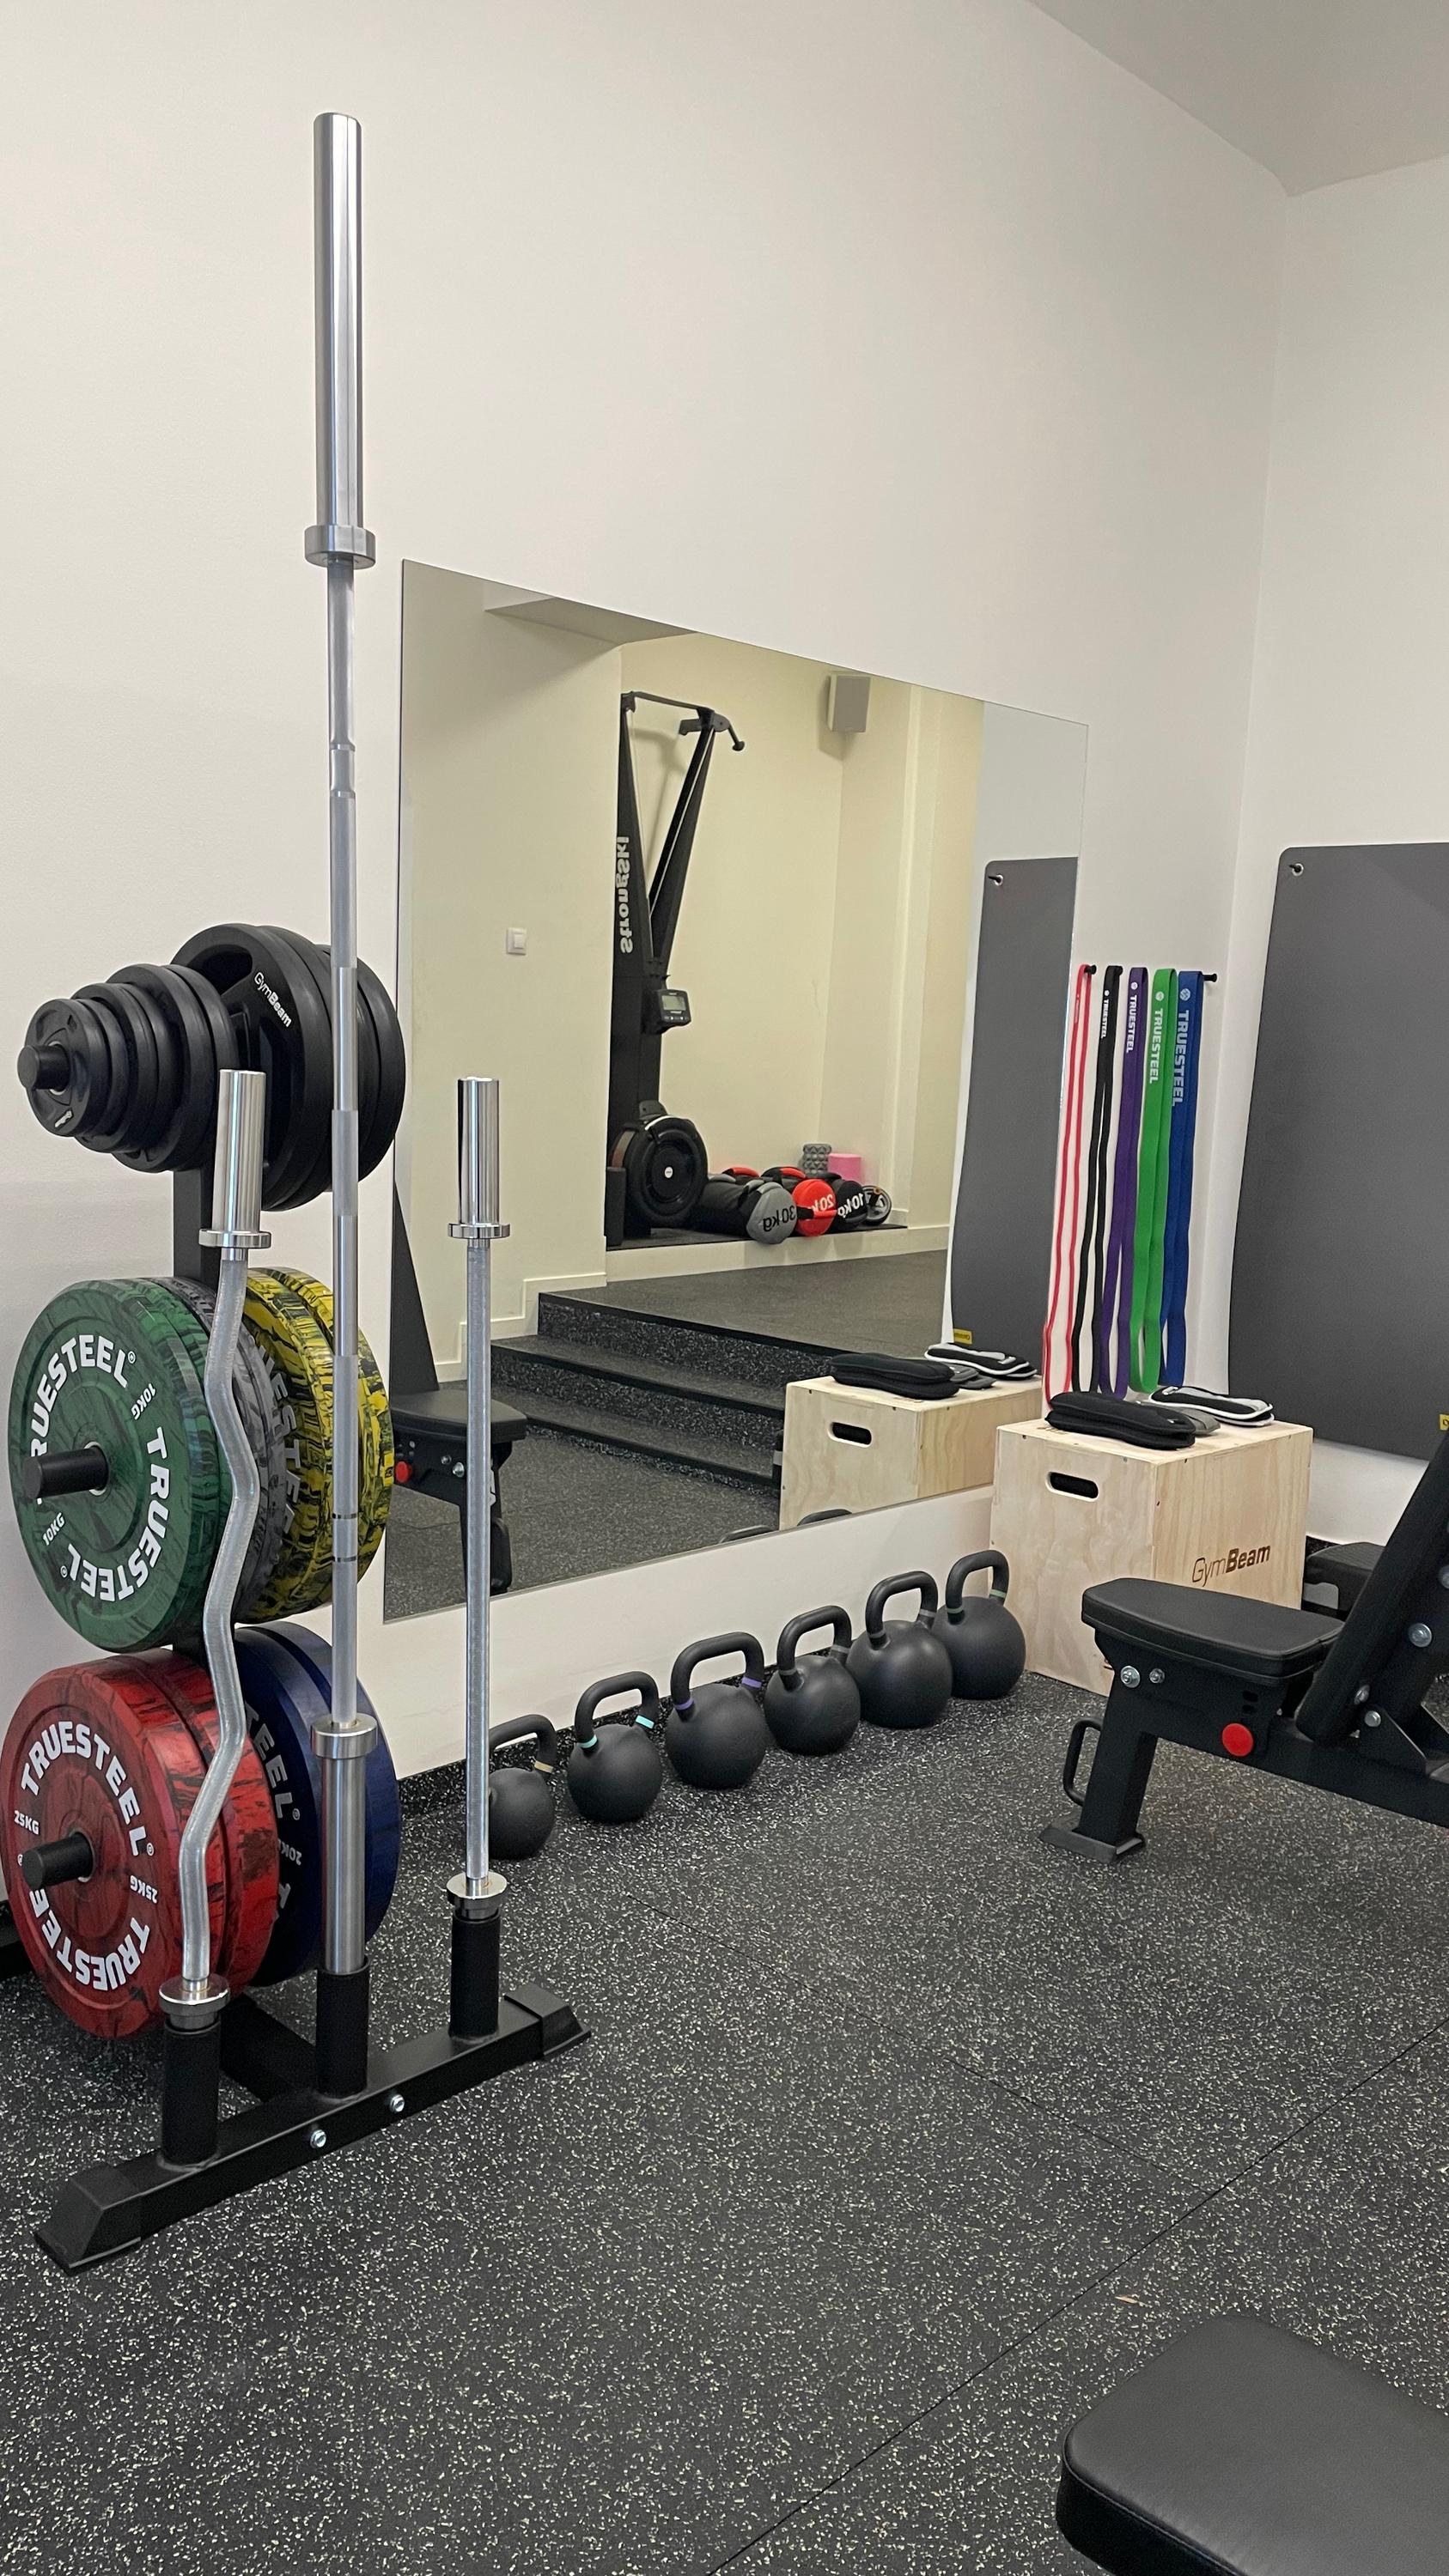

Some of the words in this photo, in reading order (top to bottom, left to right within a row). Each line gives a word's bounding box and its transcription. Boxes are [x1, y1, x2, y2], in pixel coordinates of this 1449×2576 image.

[254, 971, 292, 1027] GymBeam
[1100, 999, 1109, 1039] TRUESTEEL
[1126, 994, 1137, 1054] TRUESTEEL
[1149, 1008, 1163, 1084] TRUESTEEL
[1172, 1010, 1190, 1107] TRUESTEEL
[131, 1382, 156, 1420] 10KG
[42, 1512, 65, 1546] 10KG
[1192, 1546, 1270, 1587] GymBeam
[14, 1809, 39, 1835] 25KG
[129, 1874, 159, 1905] 25KG
